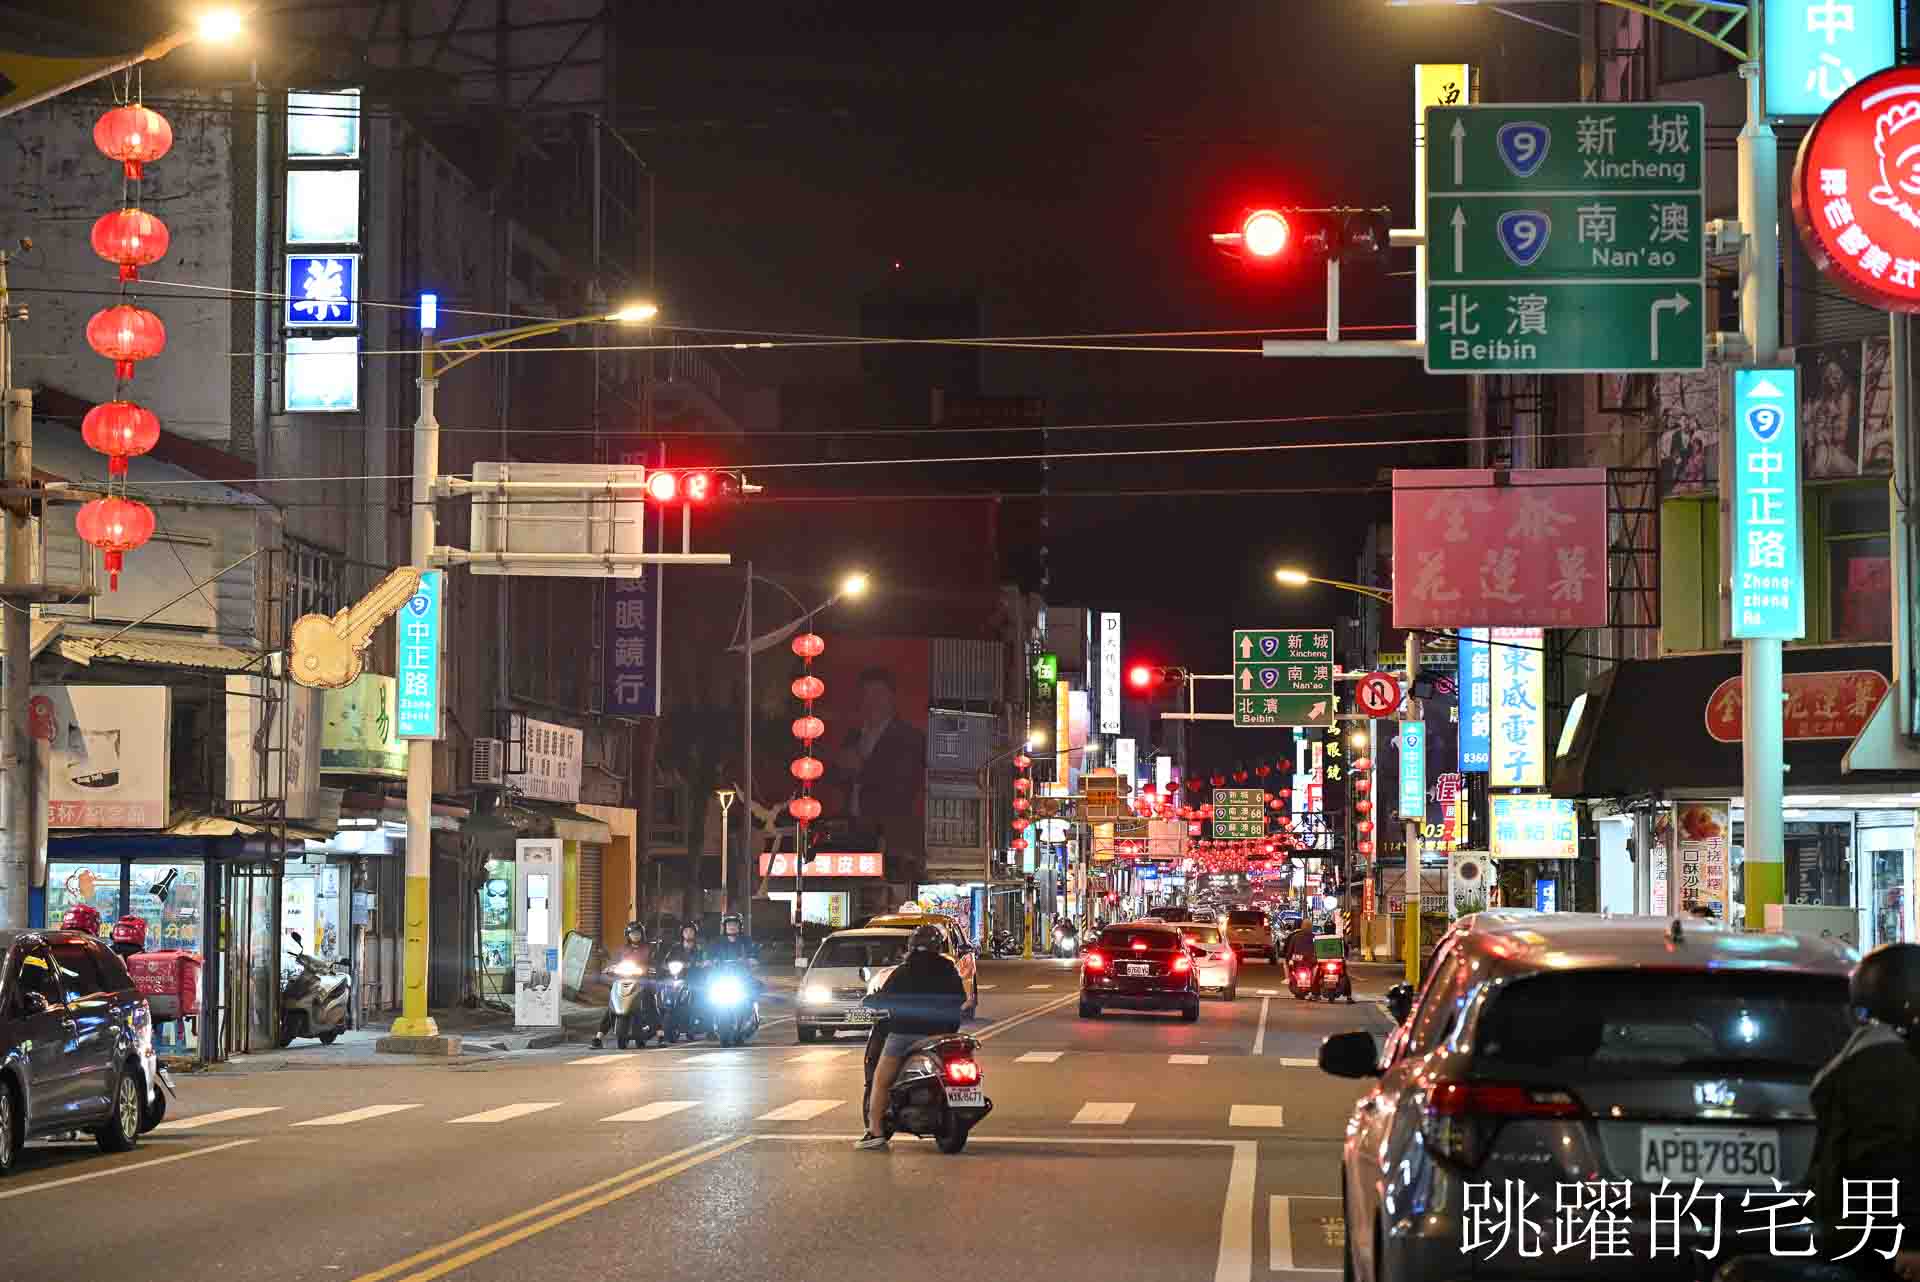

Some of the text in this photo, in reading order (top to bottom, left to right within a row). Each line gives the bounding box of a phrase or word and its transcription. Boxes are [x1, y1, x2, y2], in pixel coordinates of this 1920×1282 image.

[1807, 0, 1857, 99] 中心
[1577, 115, 1690, 155] 新城
[1513, 133, 1537, 161] 9
[1584, 160, 1686, 182] Xincheng
[1577, 203, 1690, 243] 南澳
[1513, 221, 1537, 249] 9
[1592, 247, 1676, 267] Nan'ao
[1439, 294, 1548, 336] 北濱
[1450, 340, 1537, 361] Beibin
[1757, 410, 1775, 431] 9
[1746, 448, 1785, 568] 中正路
[1266, 640, 1274, 651] 9
[1288, 634, 1329, 649] 新城
[407, 621, 429, 696] 中正路
[1289, 650, 1328, 658] Xincheng
[1266, 672, 1274, 683] 9
[1288, 666, 1329, 681] 南澳
[1239, 698, 1278, 714] 北濱
[1503, 643, 1536, 782] 東威電子
[1242, 714, 1275, 723] Beibin
[1256, 793, 1262, 802] 6
[1251, 809, 1262, 818] 68
[1251, 825, 1262, 834] 88
